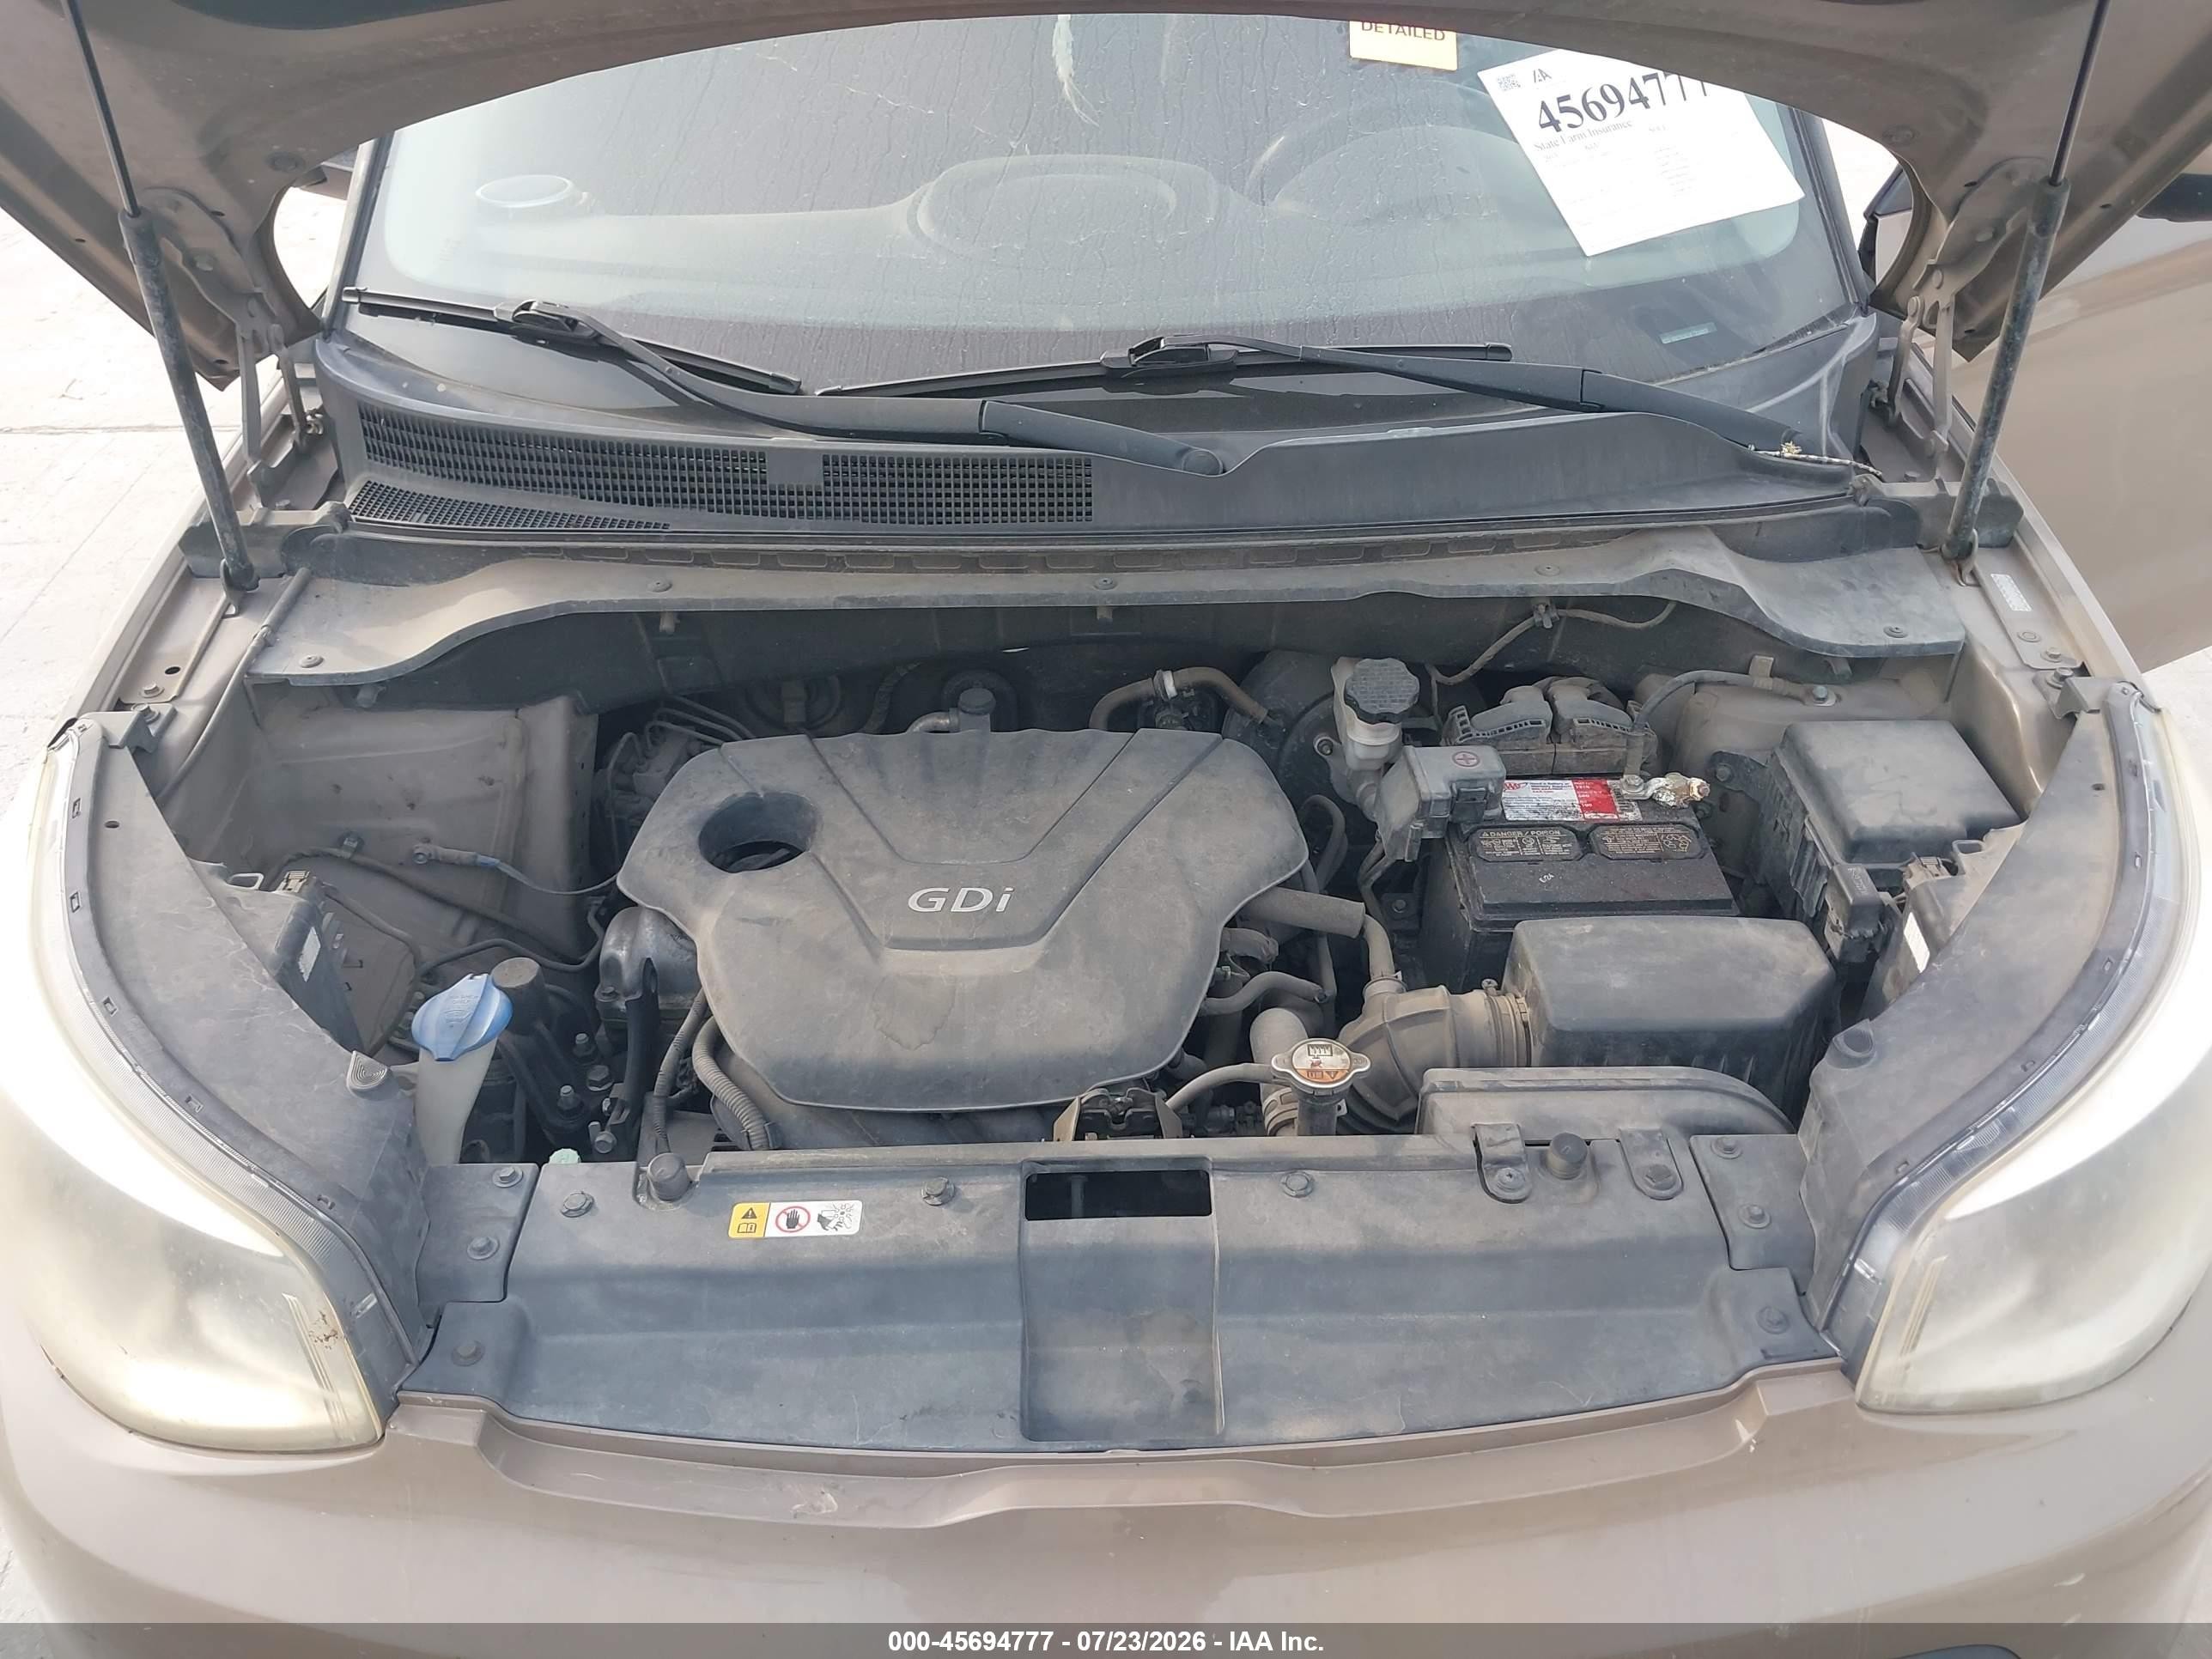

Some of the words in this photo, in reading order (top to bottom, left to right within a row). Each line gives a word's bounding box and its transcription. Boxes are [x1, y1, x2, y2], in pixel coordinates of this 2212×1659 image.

[1361, 21, 1446, 41] DETAILED
[1534, 139, 1559, 152] State
[1589, 118, 1633, 137] Insurance
[908, 887, 1015, 913] GDi
